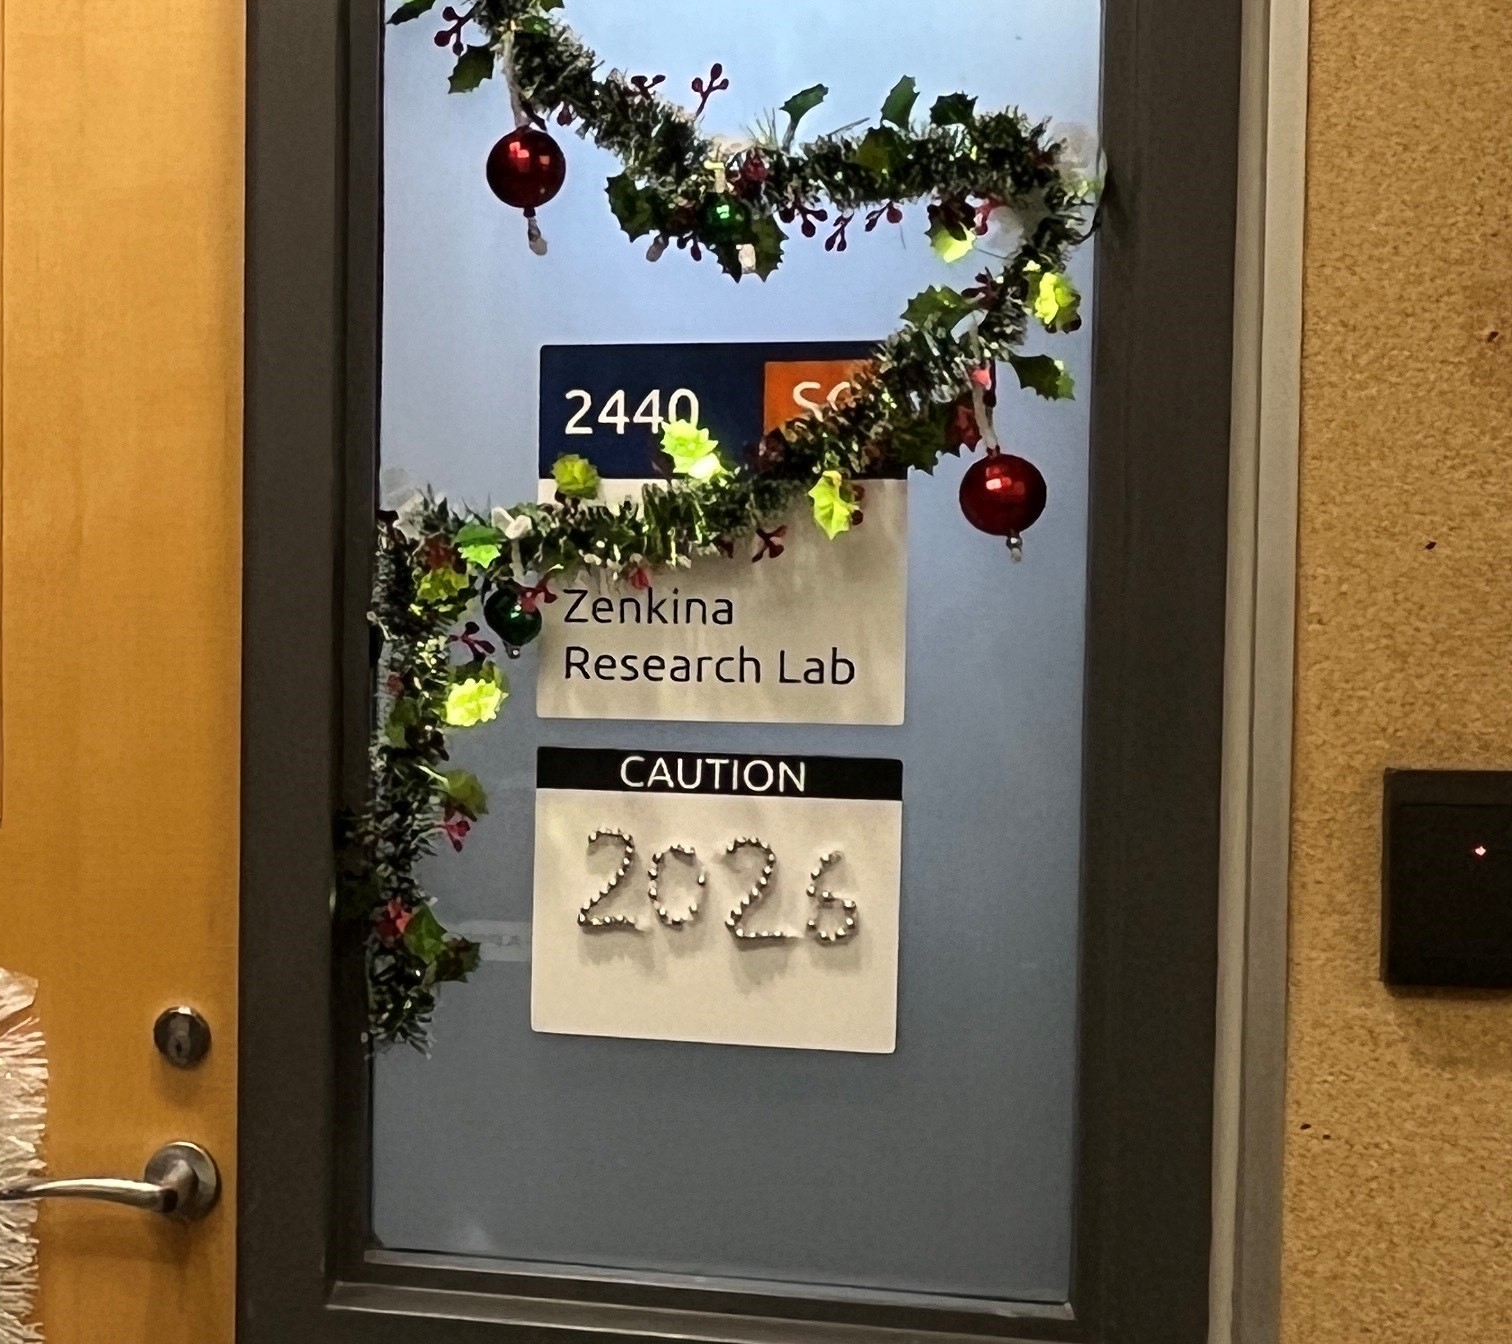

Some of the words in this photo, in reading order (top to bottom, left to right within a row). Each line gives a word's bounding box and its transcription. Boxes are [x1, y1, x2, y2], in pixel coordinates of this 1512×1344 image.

[565, 388, 699, 435] 2440
[563, 587, 734, 625] Zenkina
[565, 645, 761, 683] Research
[779, 646, 855, 685] Lab
[620, 755, 806, 793] CAUTION
[577, 823, 857, 945] 2026
